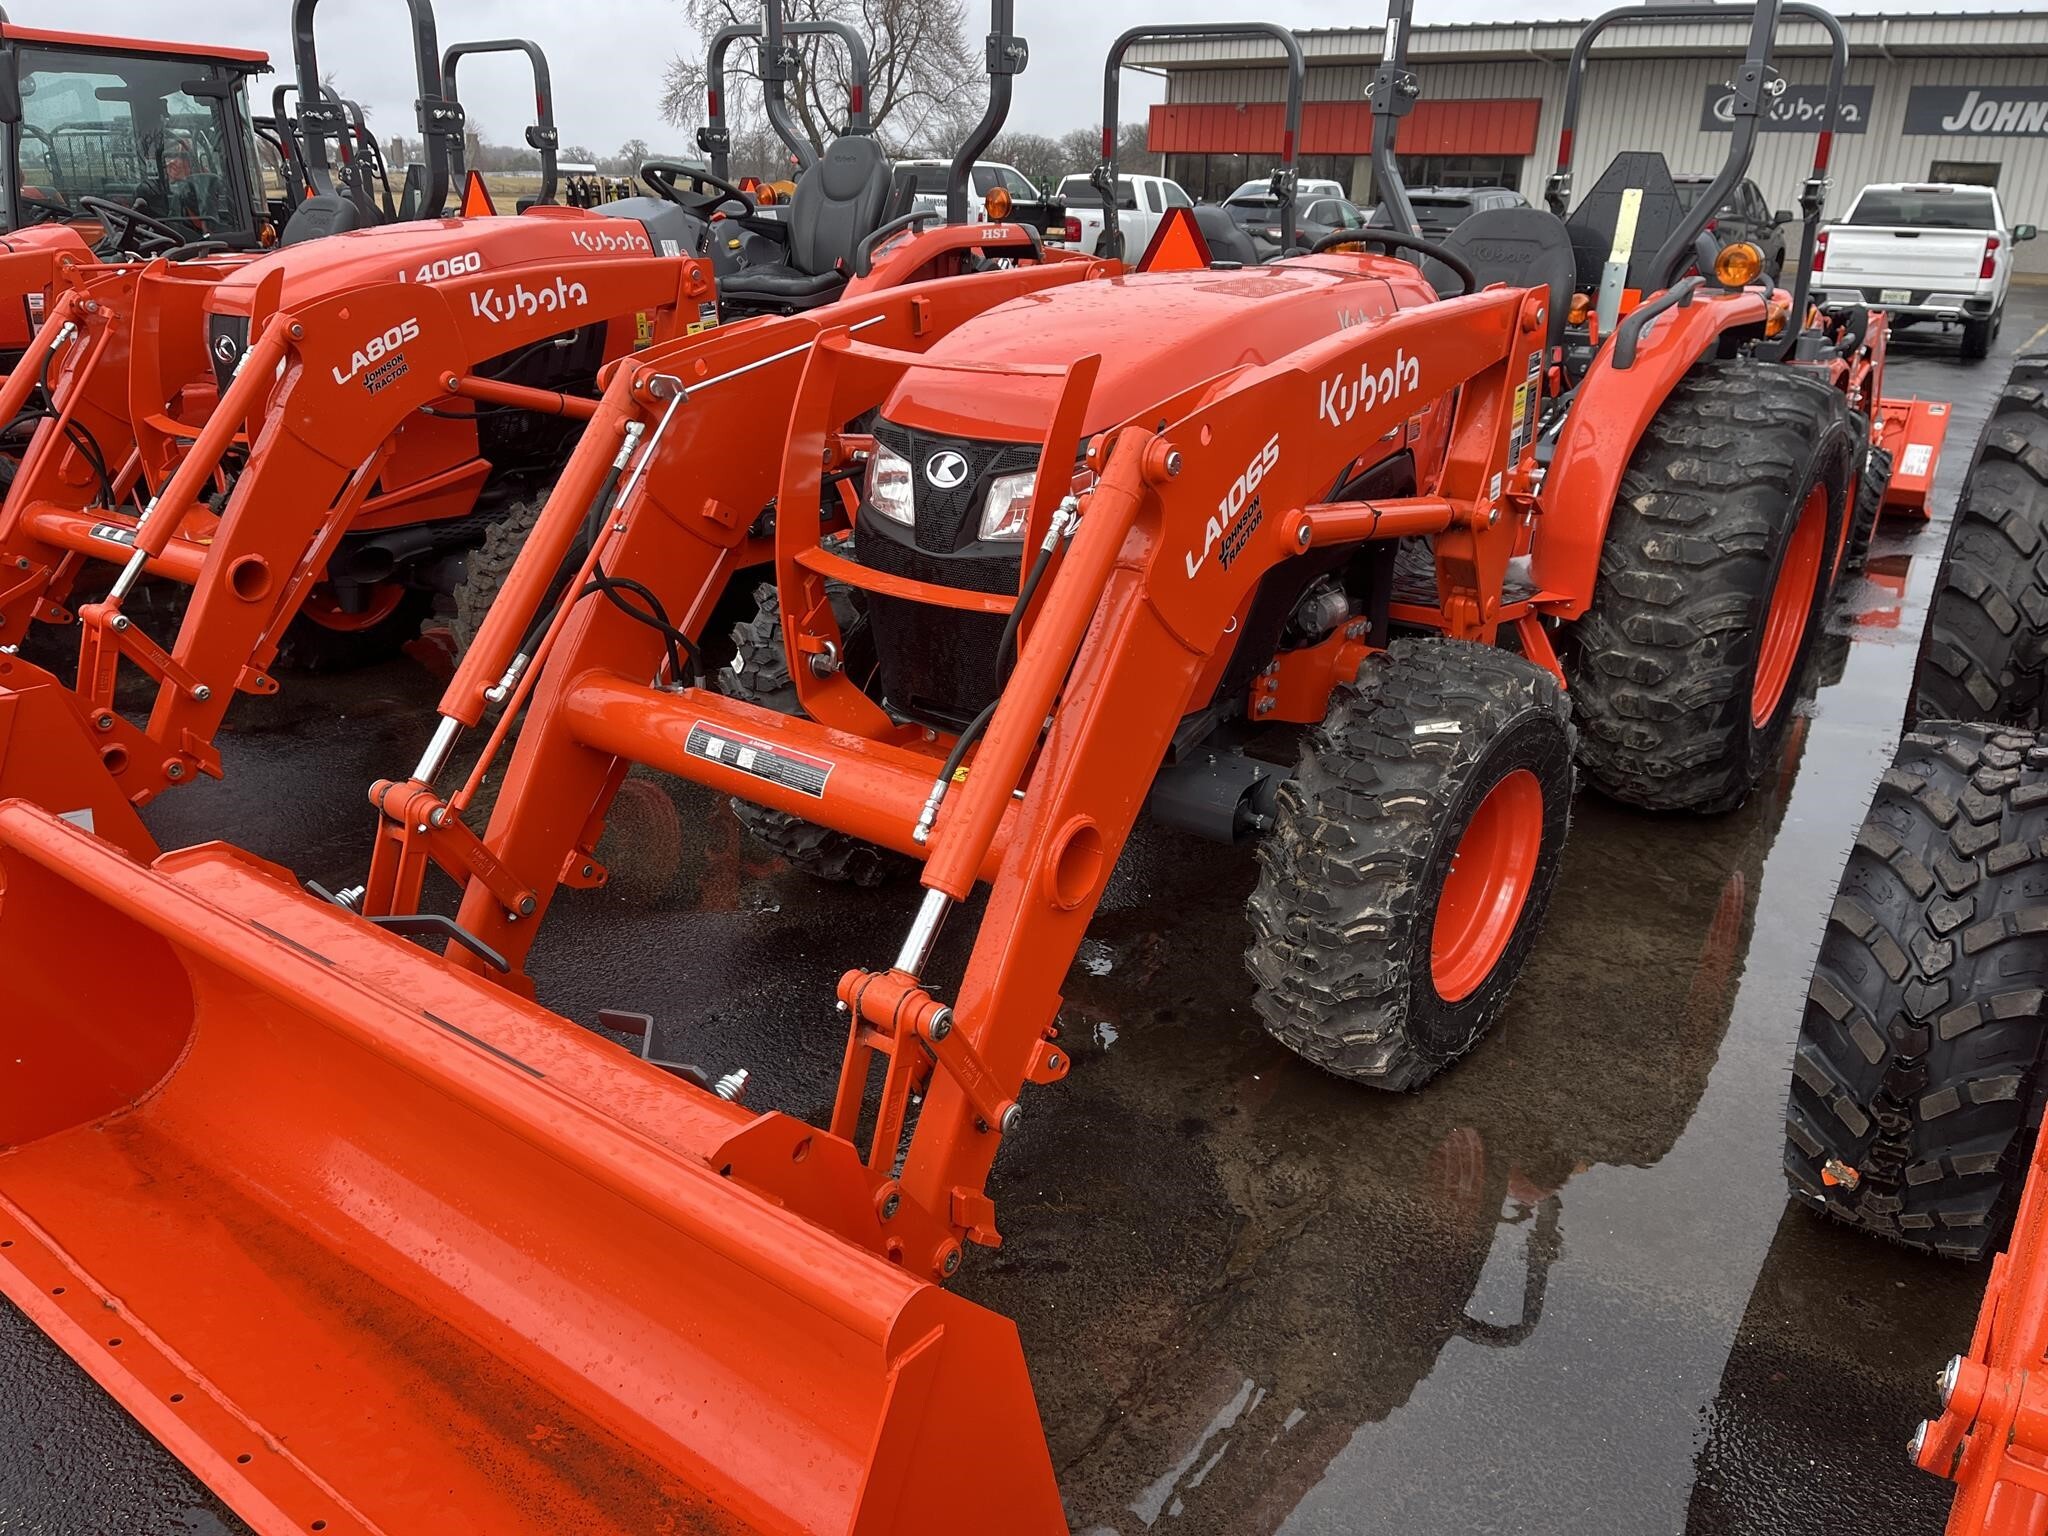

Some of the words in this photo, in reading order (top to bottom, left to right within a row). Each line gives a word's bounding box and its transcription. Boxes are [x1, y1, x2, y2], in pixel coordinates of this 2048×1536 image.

[1942, 90, 2048, 133] JOHN
[571, 230, 650, 252] Kubota
[982, 228, 1009, 239] HST
[470, 276, 588, 323] Kubota
[332, 317, 420, 385] LA805
[363, 353, 404, 386] JOHNSON
[366, 364, 408, 395] TRACTOR
[1319, 348, 1420, 427] Kubota
[1185, 431, 1280, 579] LA1065
[1218, 494, 1261, 561] JOHNSON
[1221, 510, 1263, 572] TRACTOR
